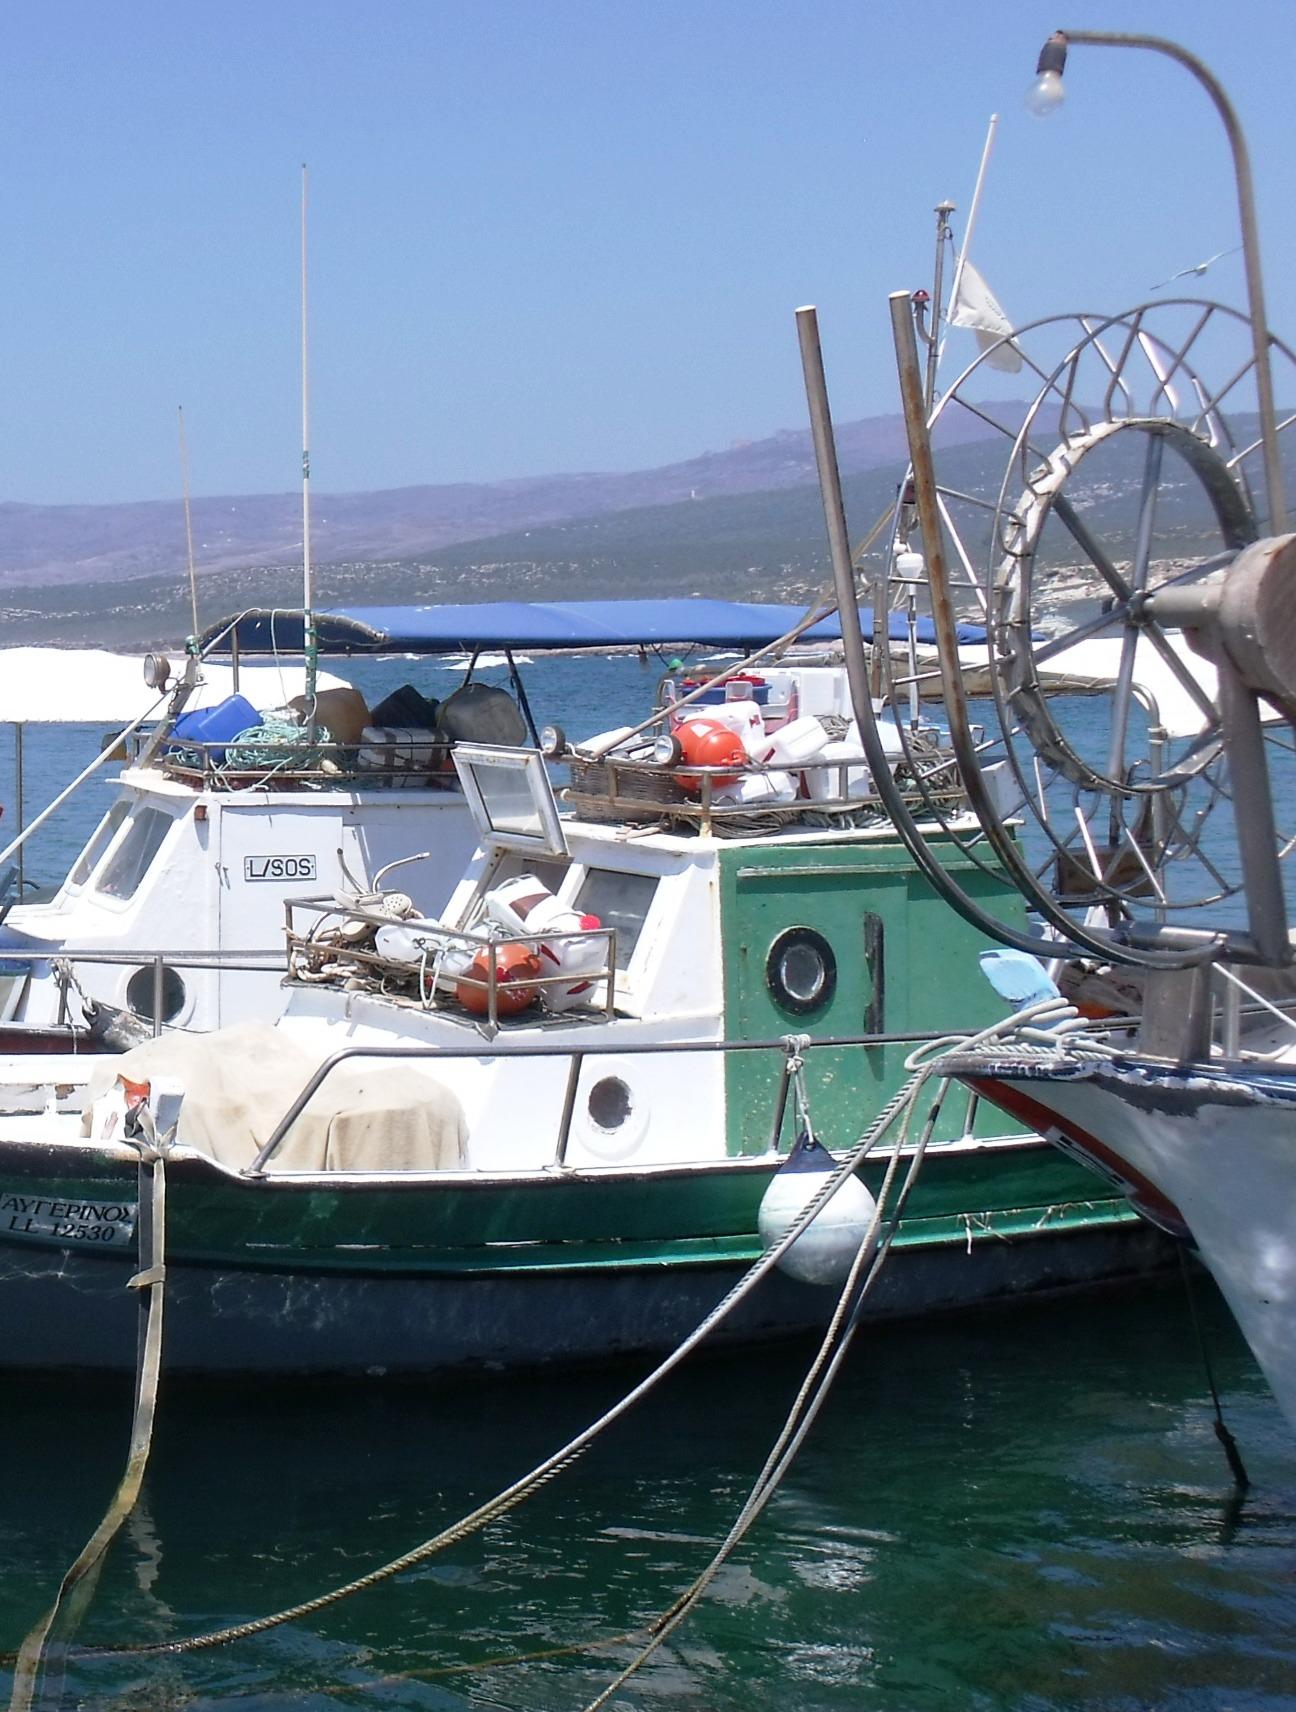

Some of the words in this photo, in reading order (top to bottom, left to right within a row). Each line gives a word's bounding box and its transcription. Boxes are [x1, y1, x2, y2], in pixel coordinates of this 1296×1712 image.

[1, 1197, 133, 1224] ΑΥΓΕΡΙΝΟΣ
[9, 1215, 40, 1235] LL
[50, 1220, 116, 1243] 12530
